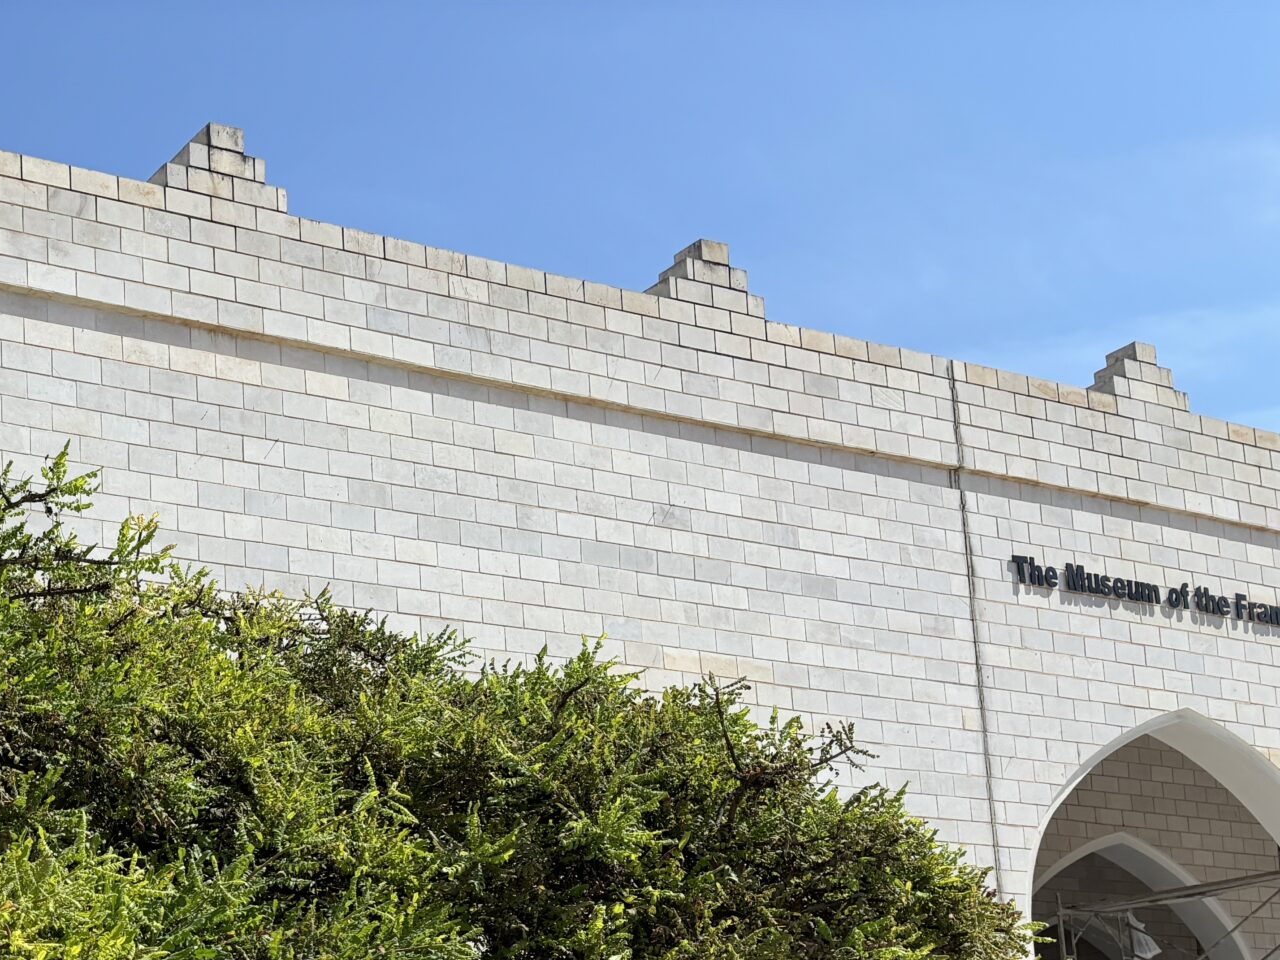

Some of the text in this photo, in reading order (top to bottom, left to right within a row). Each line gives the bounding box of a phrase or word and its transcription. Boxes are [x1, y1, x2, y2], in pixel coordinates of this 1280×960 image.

[1012, 555, 1058, 588] The
[1066, 563, 1161, 604] Museum
[1168, 583, 1190, 609] of
[1195, 585, 1231, 615] the
